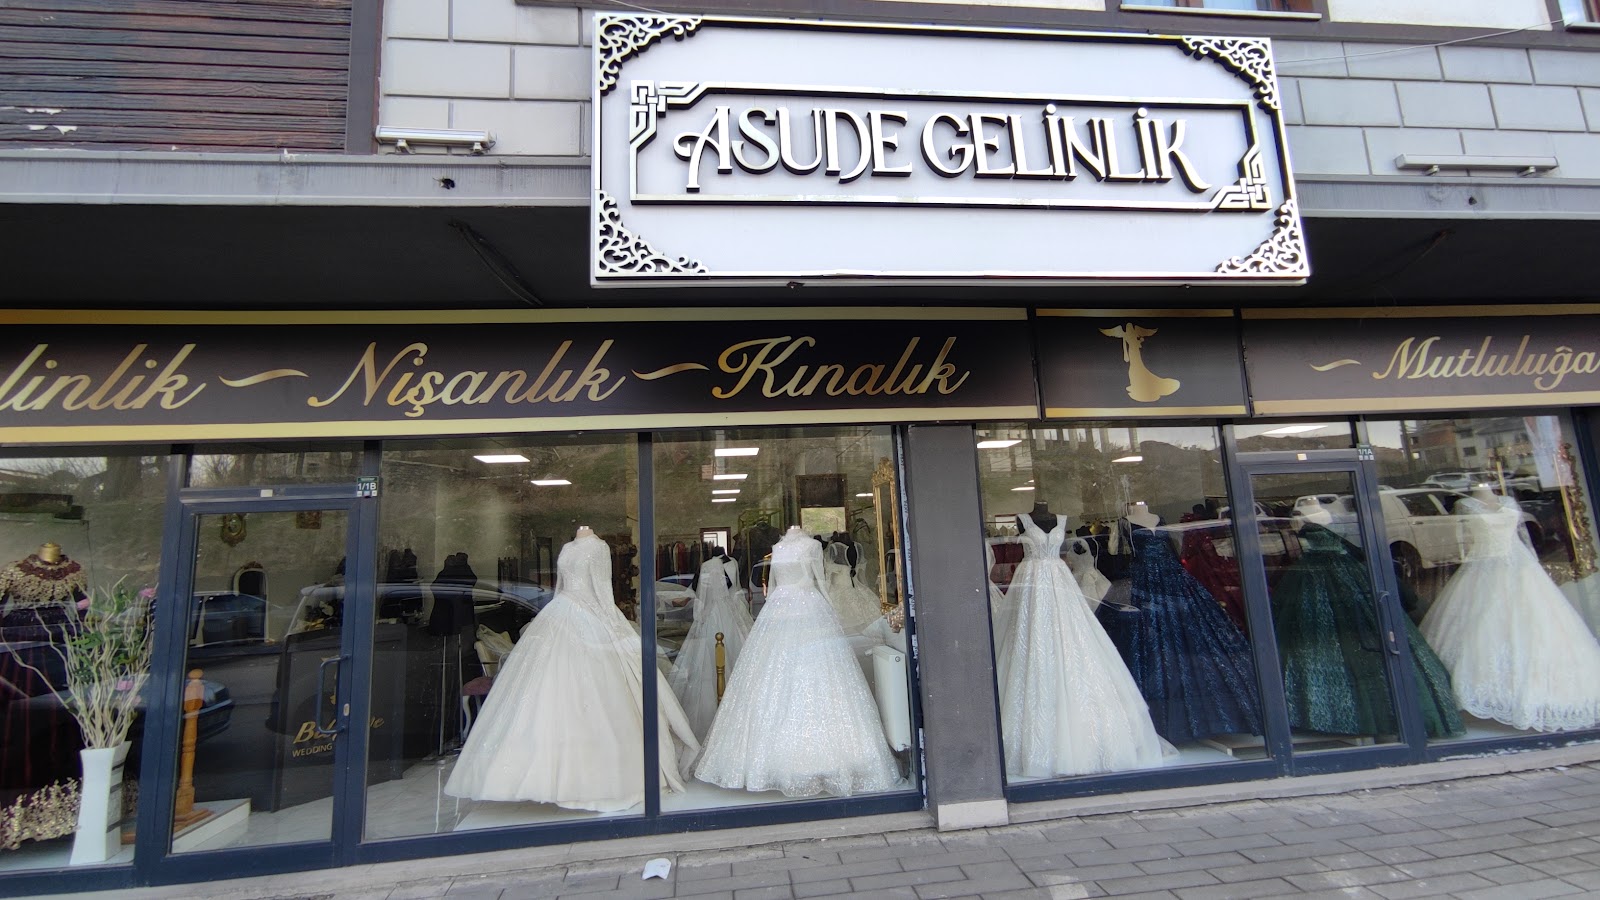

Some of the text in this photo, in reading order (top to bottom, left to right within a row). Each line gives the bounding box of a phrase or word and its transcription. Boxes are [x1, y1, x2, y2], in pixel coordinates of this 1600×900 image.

[673, 105, 913, 193] ASUDE
[307, 339, 626, 418] Nişanlık
[711, 335, 970, 399] Kınalık
[358, 482, 377, 491] 1/1B
[292, 742, 333, 758] WEDDING
